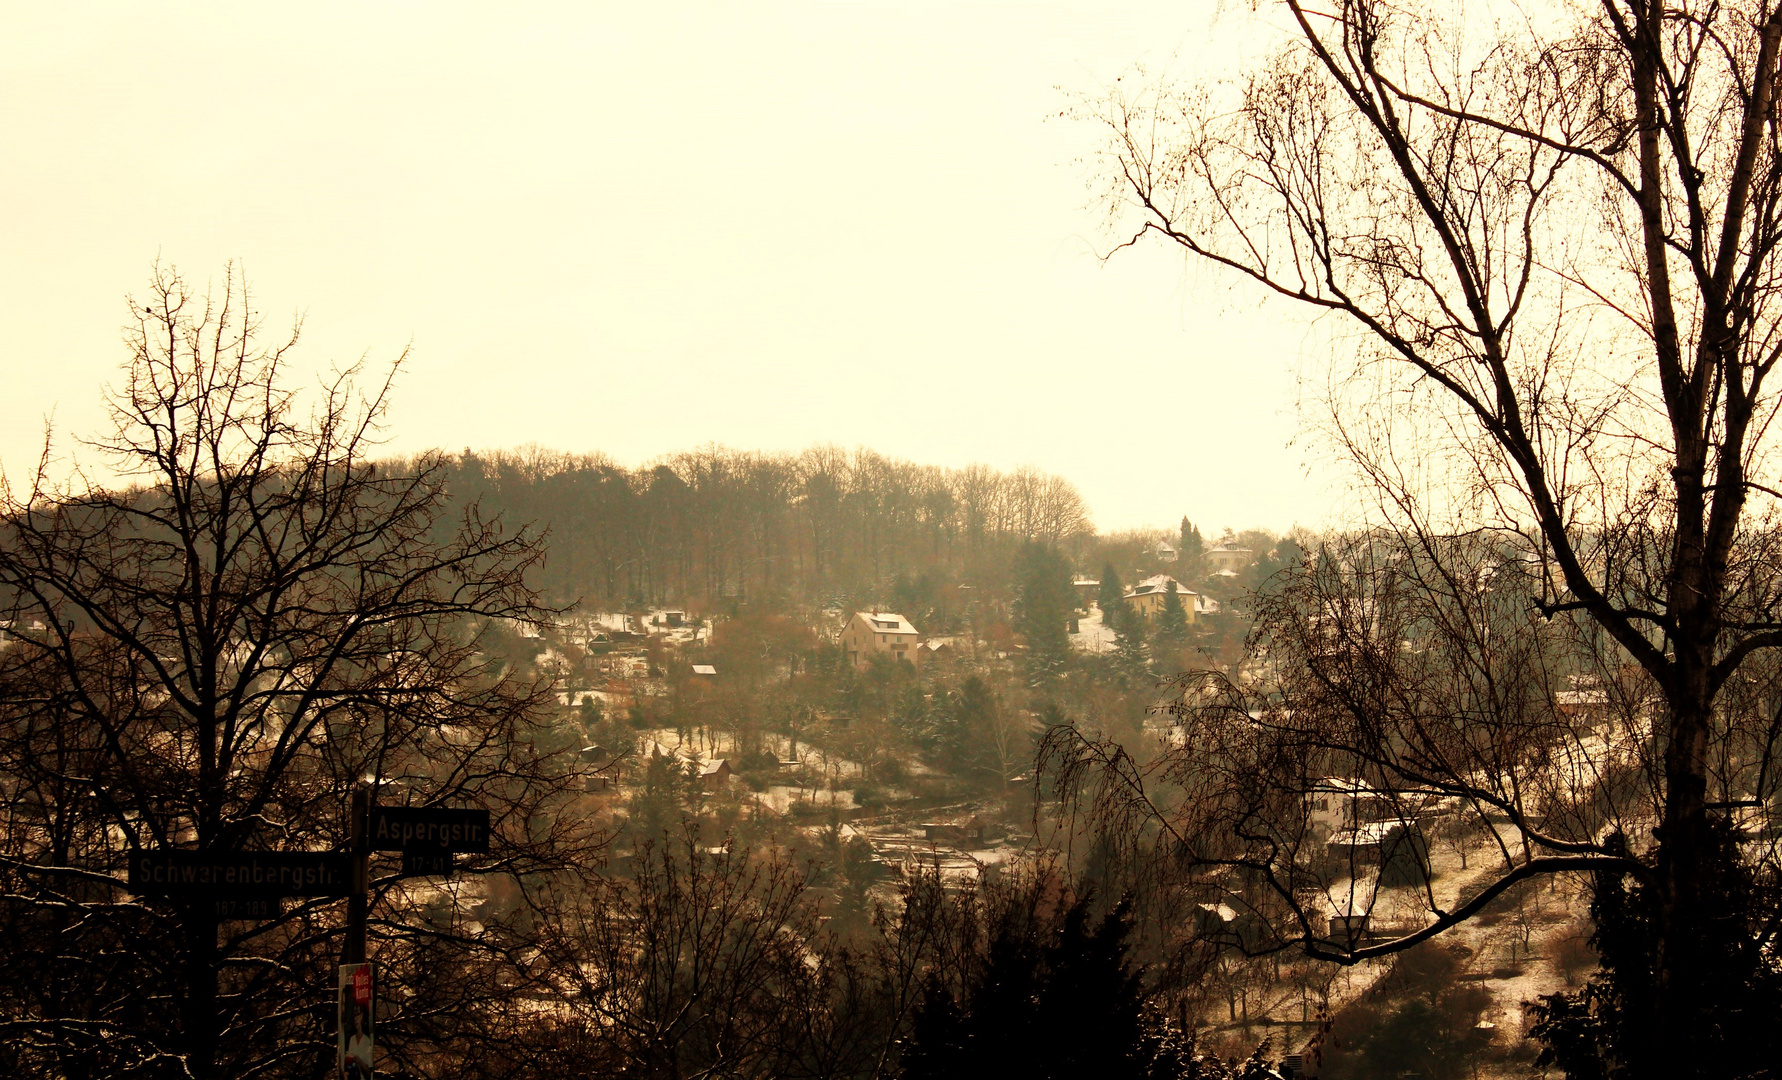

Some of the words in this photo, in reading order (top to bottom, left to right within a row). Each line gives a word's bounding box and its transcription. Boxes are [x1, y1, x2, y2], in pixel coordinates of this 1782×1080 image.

[376, 814, 482, 847] Aspergstr.
[139, 857, 342, 891] Schwarenbergstr.
[412, 856, 445, 872] 17-41
